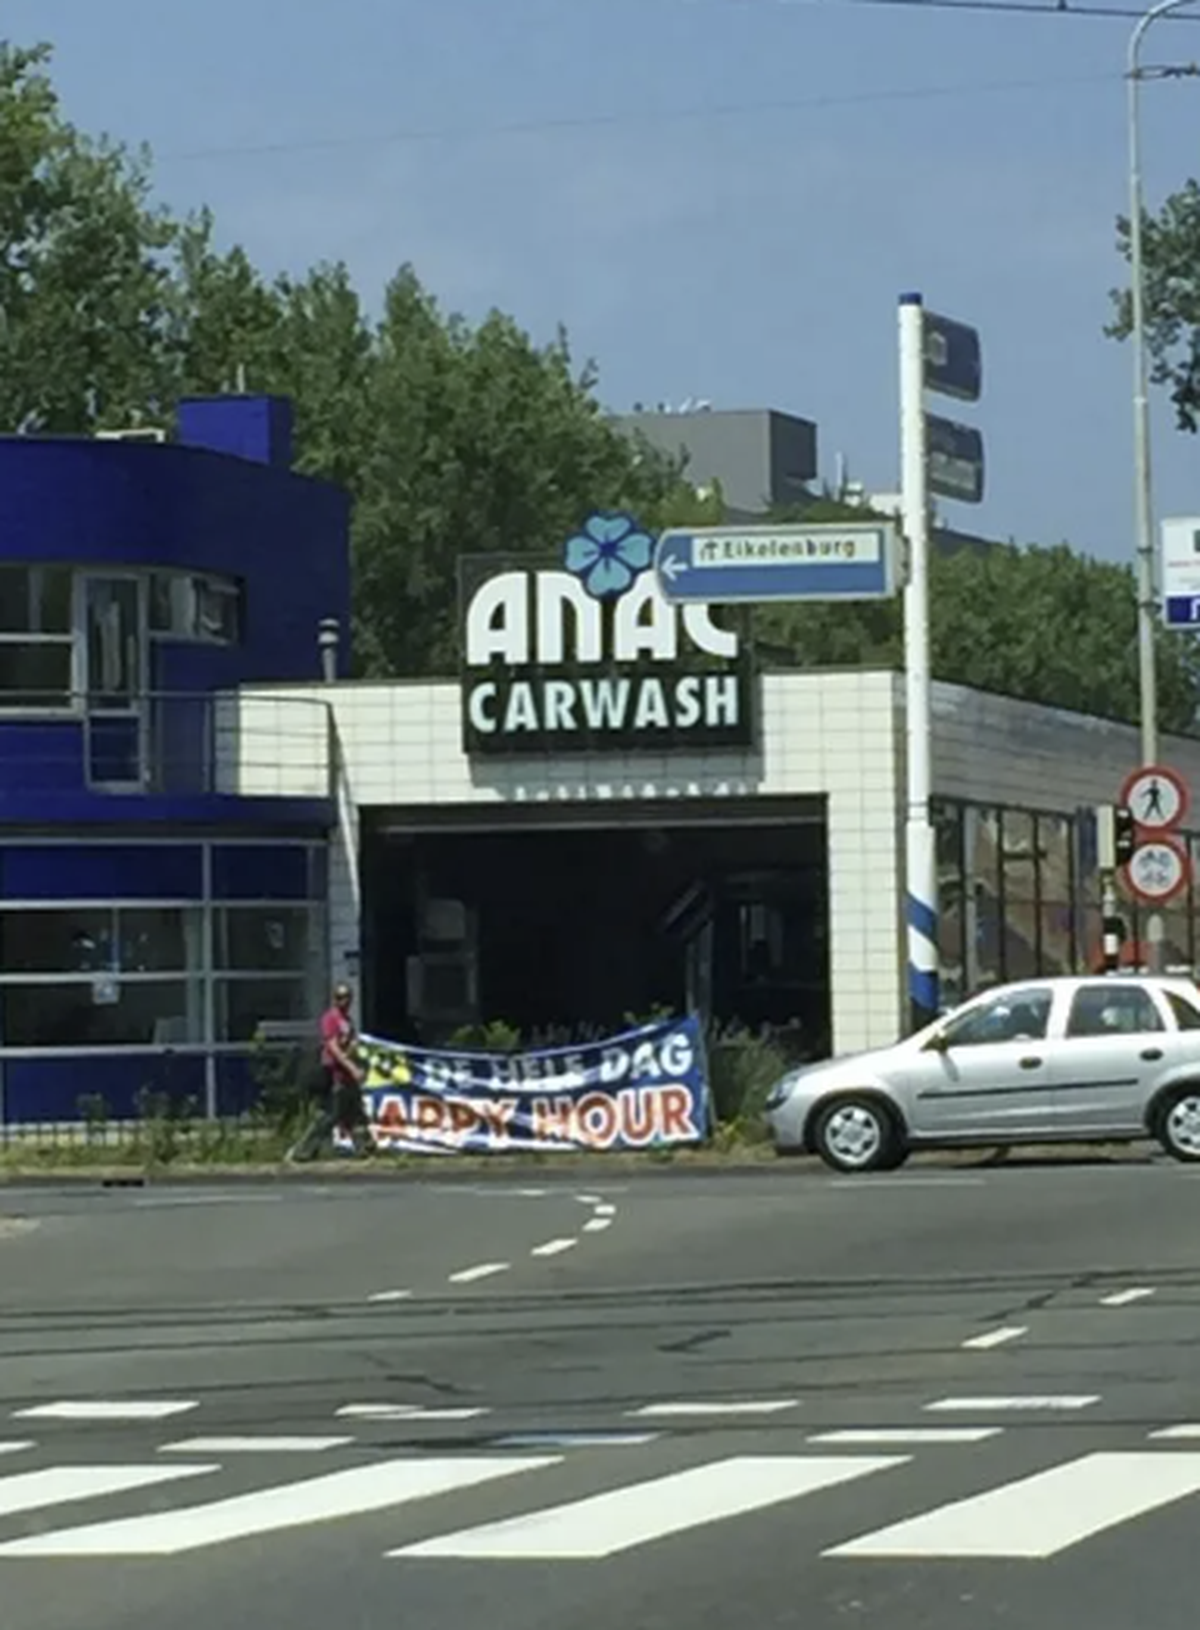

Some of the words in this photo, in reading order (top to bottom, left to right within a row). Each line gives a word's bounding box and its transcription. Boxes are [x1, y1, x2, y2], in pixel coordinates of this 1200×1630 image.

[722, 539, 857, 561] Eikelenburg
[469, 676, 738, 732] CARWASH
[426, 1055, 472, 1087] DE
[490, 1053, 587, 1090] HELE
[599, 1033, 694, 1080] DAG
[364, 1093, 516, 1142] APPY
[530, 1086, 697, 1148] HOUR
